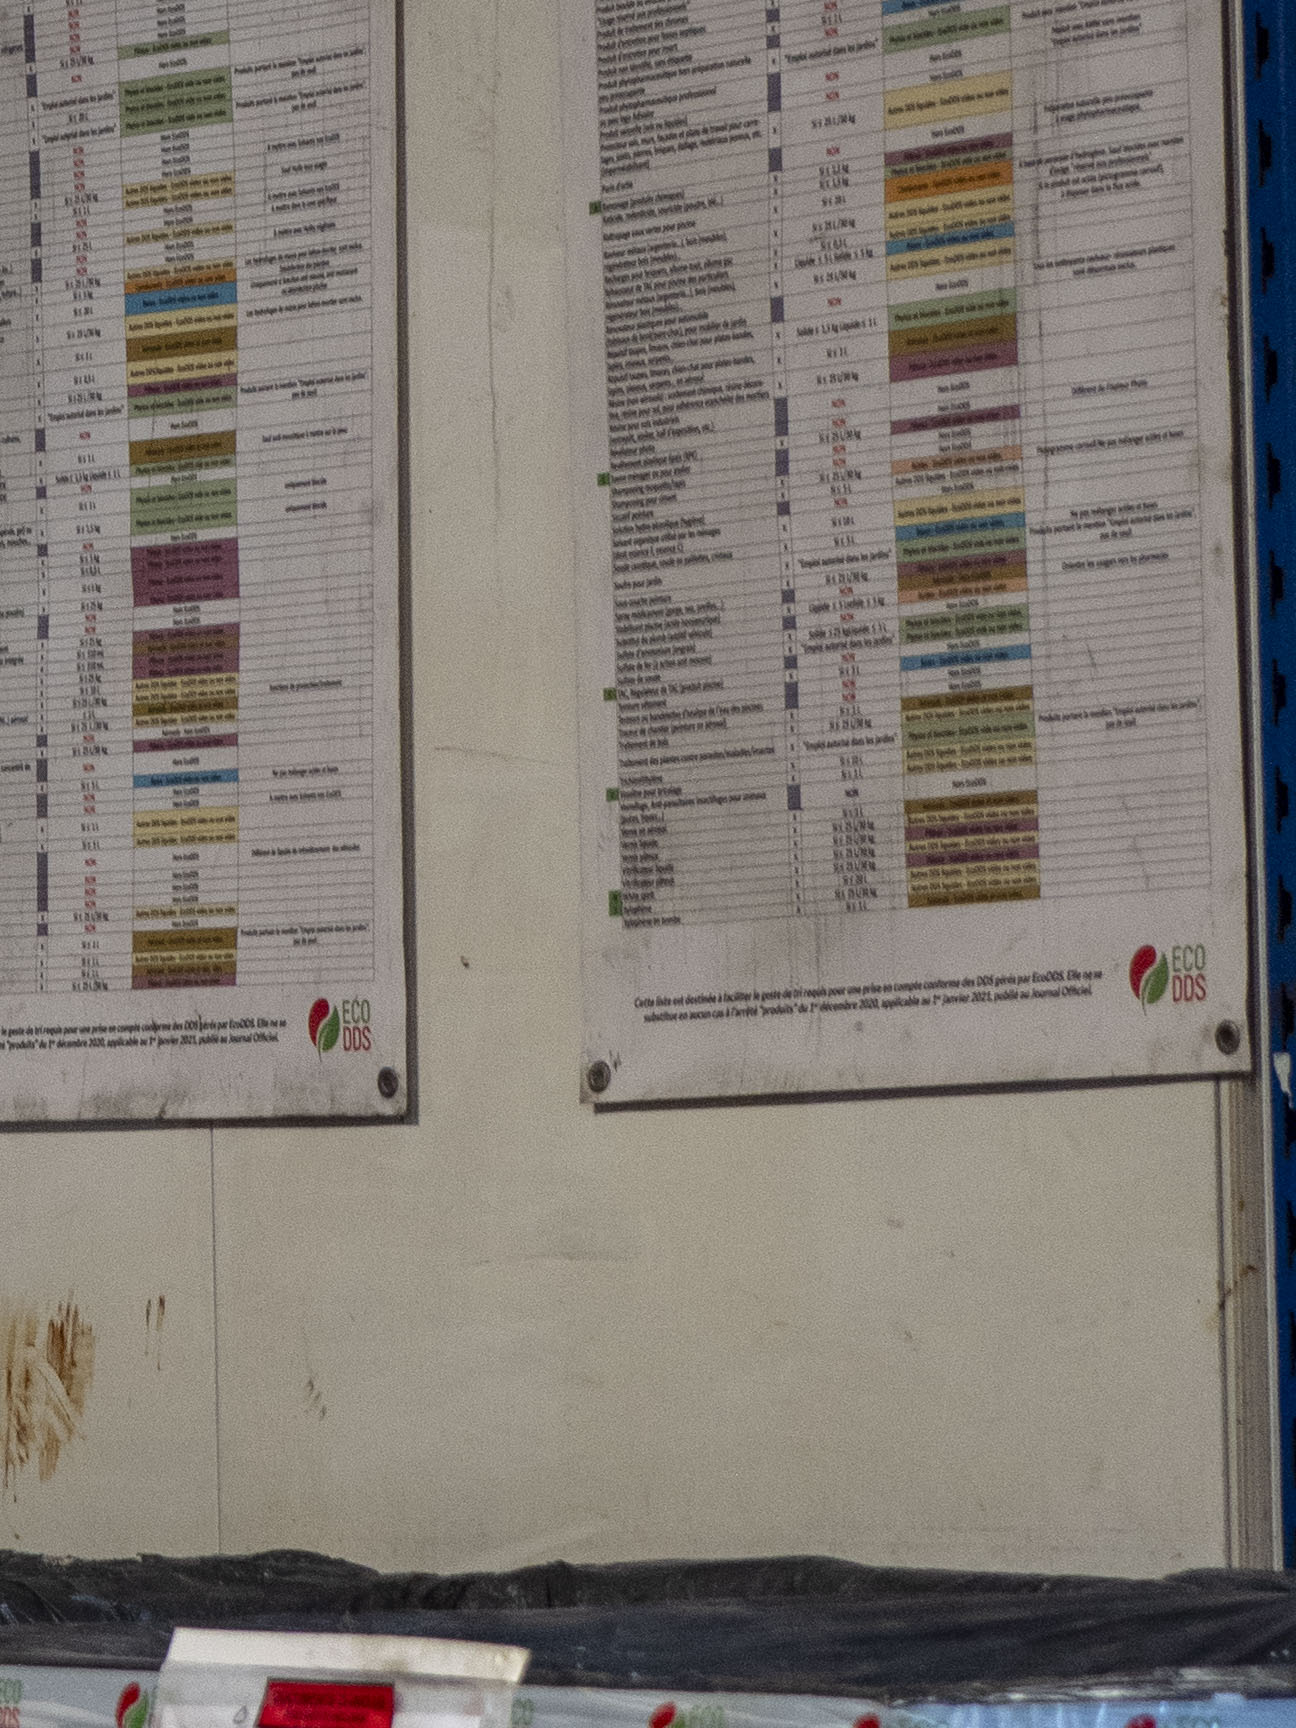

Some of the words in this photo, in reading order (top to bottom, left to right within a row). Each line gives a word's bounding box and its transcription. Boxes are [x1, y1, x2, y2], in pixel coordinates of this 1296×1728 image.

[1171, 945, 1204, 972] ECO
[1171, 973, 1205, 1002] DDS
[343, 1000, 371, 1024] ECO
[343, 1026, 371, 1051] DDS
